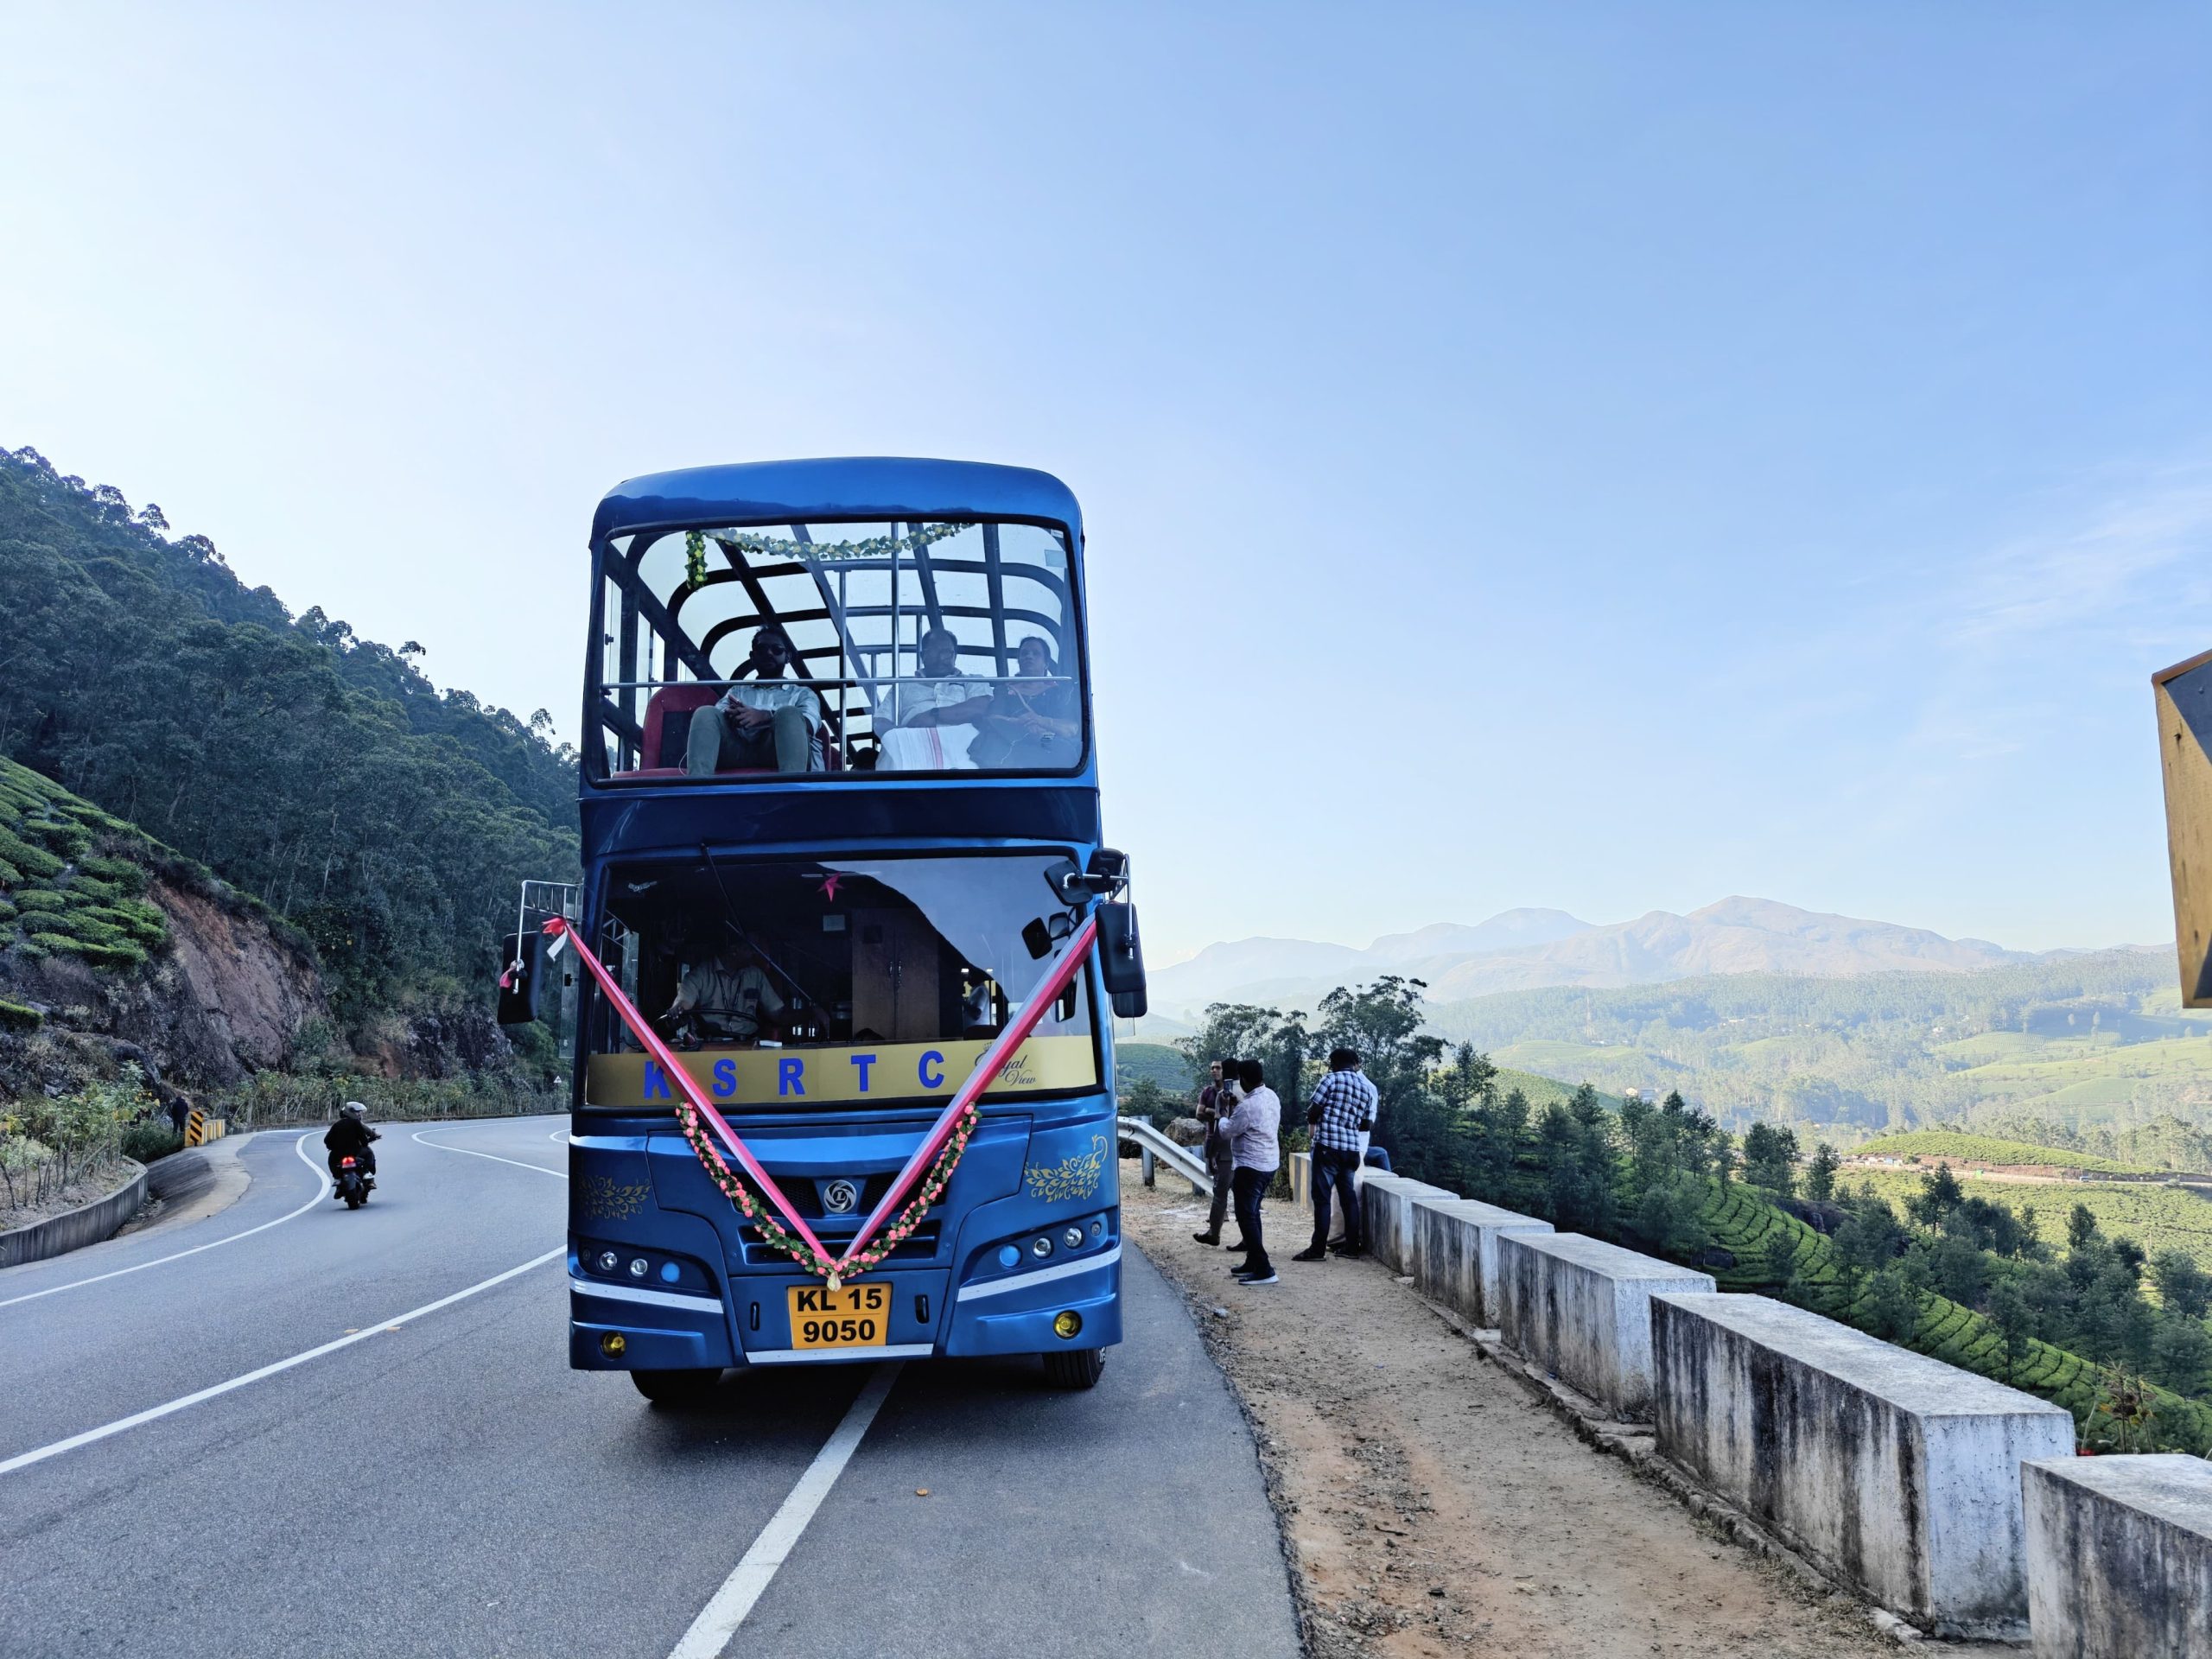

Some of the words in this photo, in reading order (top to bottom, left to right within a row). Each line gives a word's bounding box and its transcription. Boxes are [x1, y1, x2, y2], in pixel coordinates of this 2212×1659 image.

[1005, 1069, 1036, 1087] View
[798, 1290, 836, 1312] KL
[848, 1288, 882, 1310] 15
[803, 1319, 875, 1343] 9050
